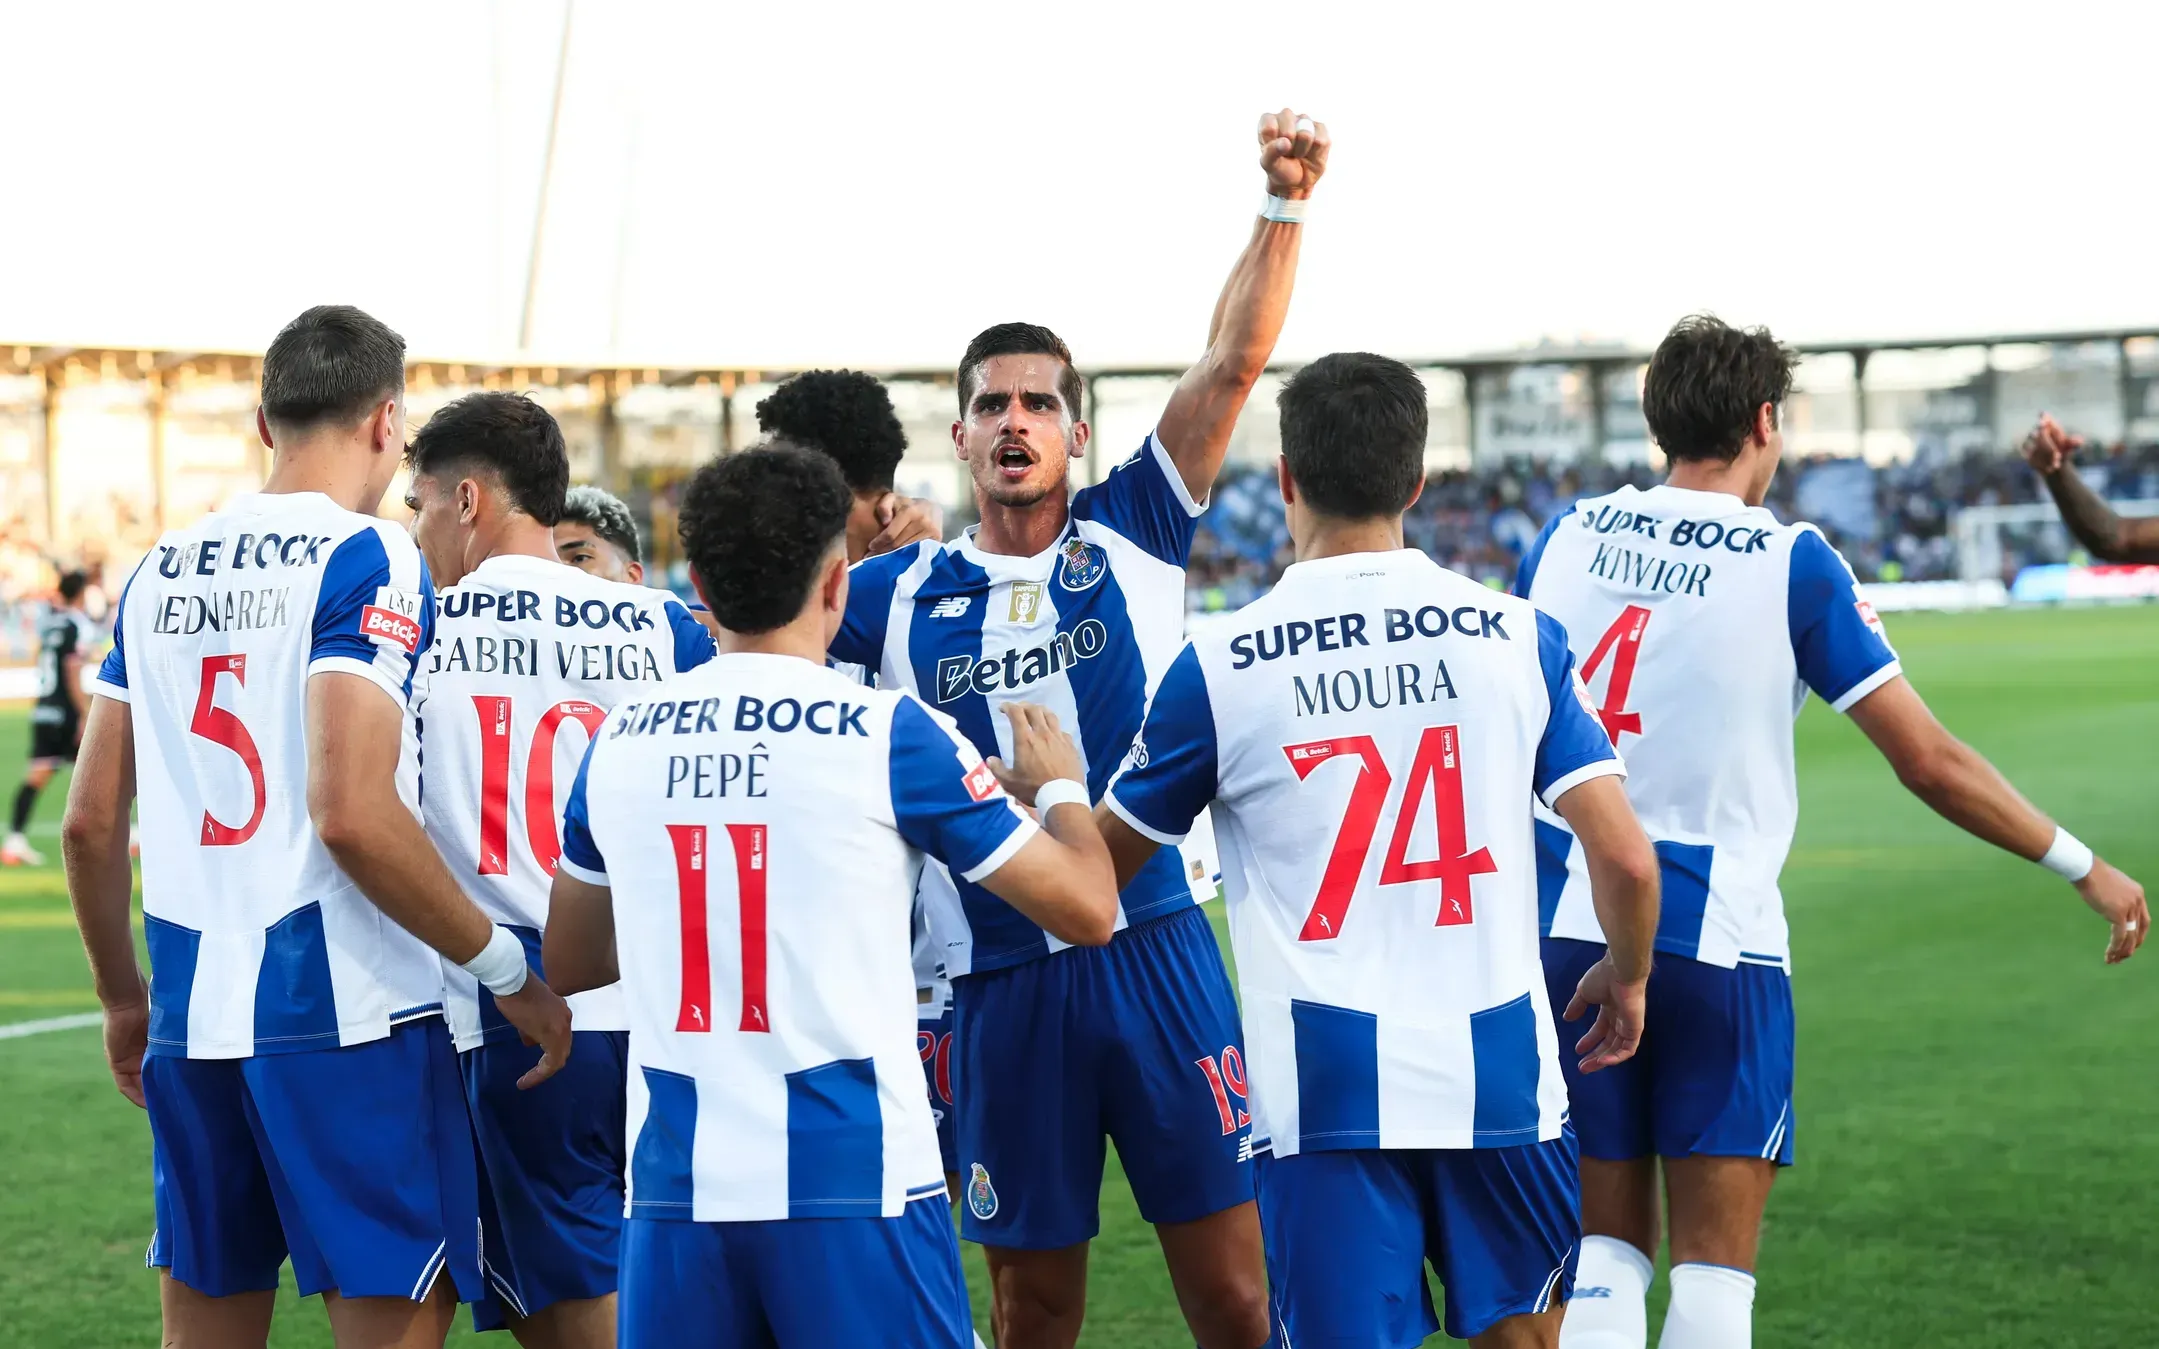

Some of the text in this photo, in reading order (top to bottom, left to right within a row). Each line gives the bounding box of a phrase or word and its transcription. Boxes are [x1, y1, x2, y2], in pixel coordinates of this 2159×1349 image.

[232, 533, 332, 569] BOCK
[1669, 519, 1774, 553] BOCK
[1588, 542, 1711, 597] KIWIOR
[556, 595, 655, 633] BOCK
[1230, 605, 1511, 670] SUPER BOCK
[555, 641, 662, 681] VEIGA
[937, 619, 1107, 704] Betano
[1293, 659, 1458, 717] MOURA
[1580, 604, 1643, 748] 4
[610, 695, 869, 739] SUPER BOCK
[190, 654, 267, 846] 5
[666, 742, 769, 798] PEPÊ
[470, 695, 607, 878] 10
[1281, 724, 1498, 942] 74
[664, 823, 770, 1033] 11
[1194, 1045, 1251, 1136] 19
